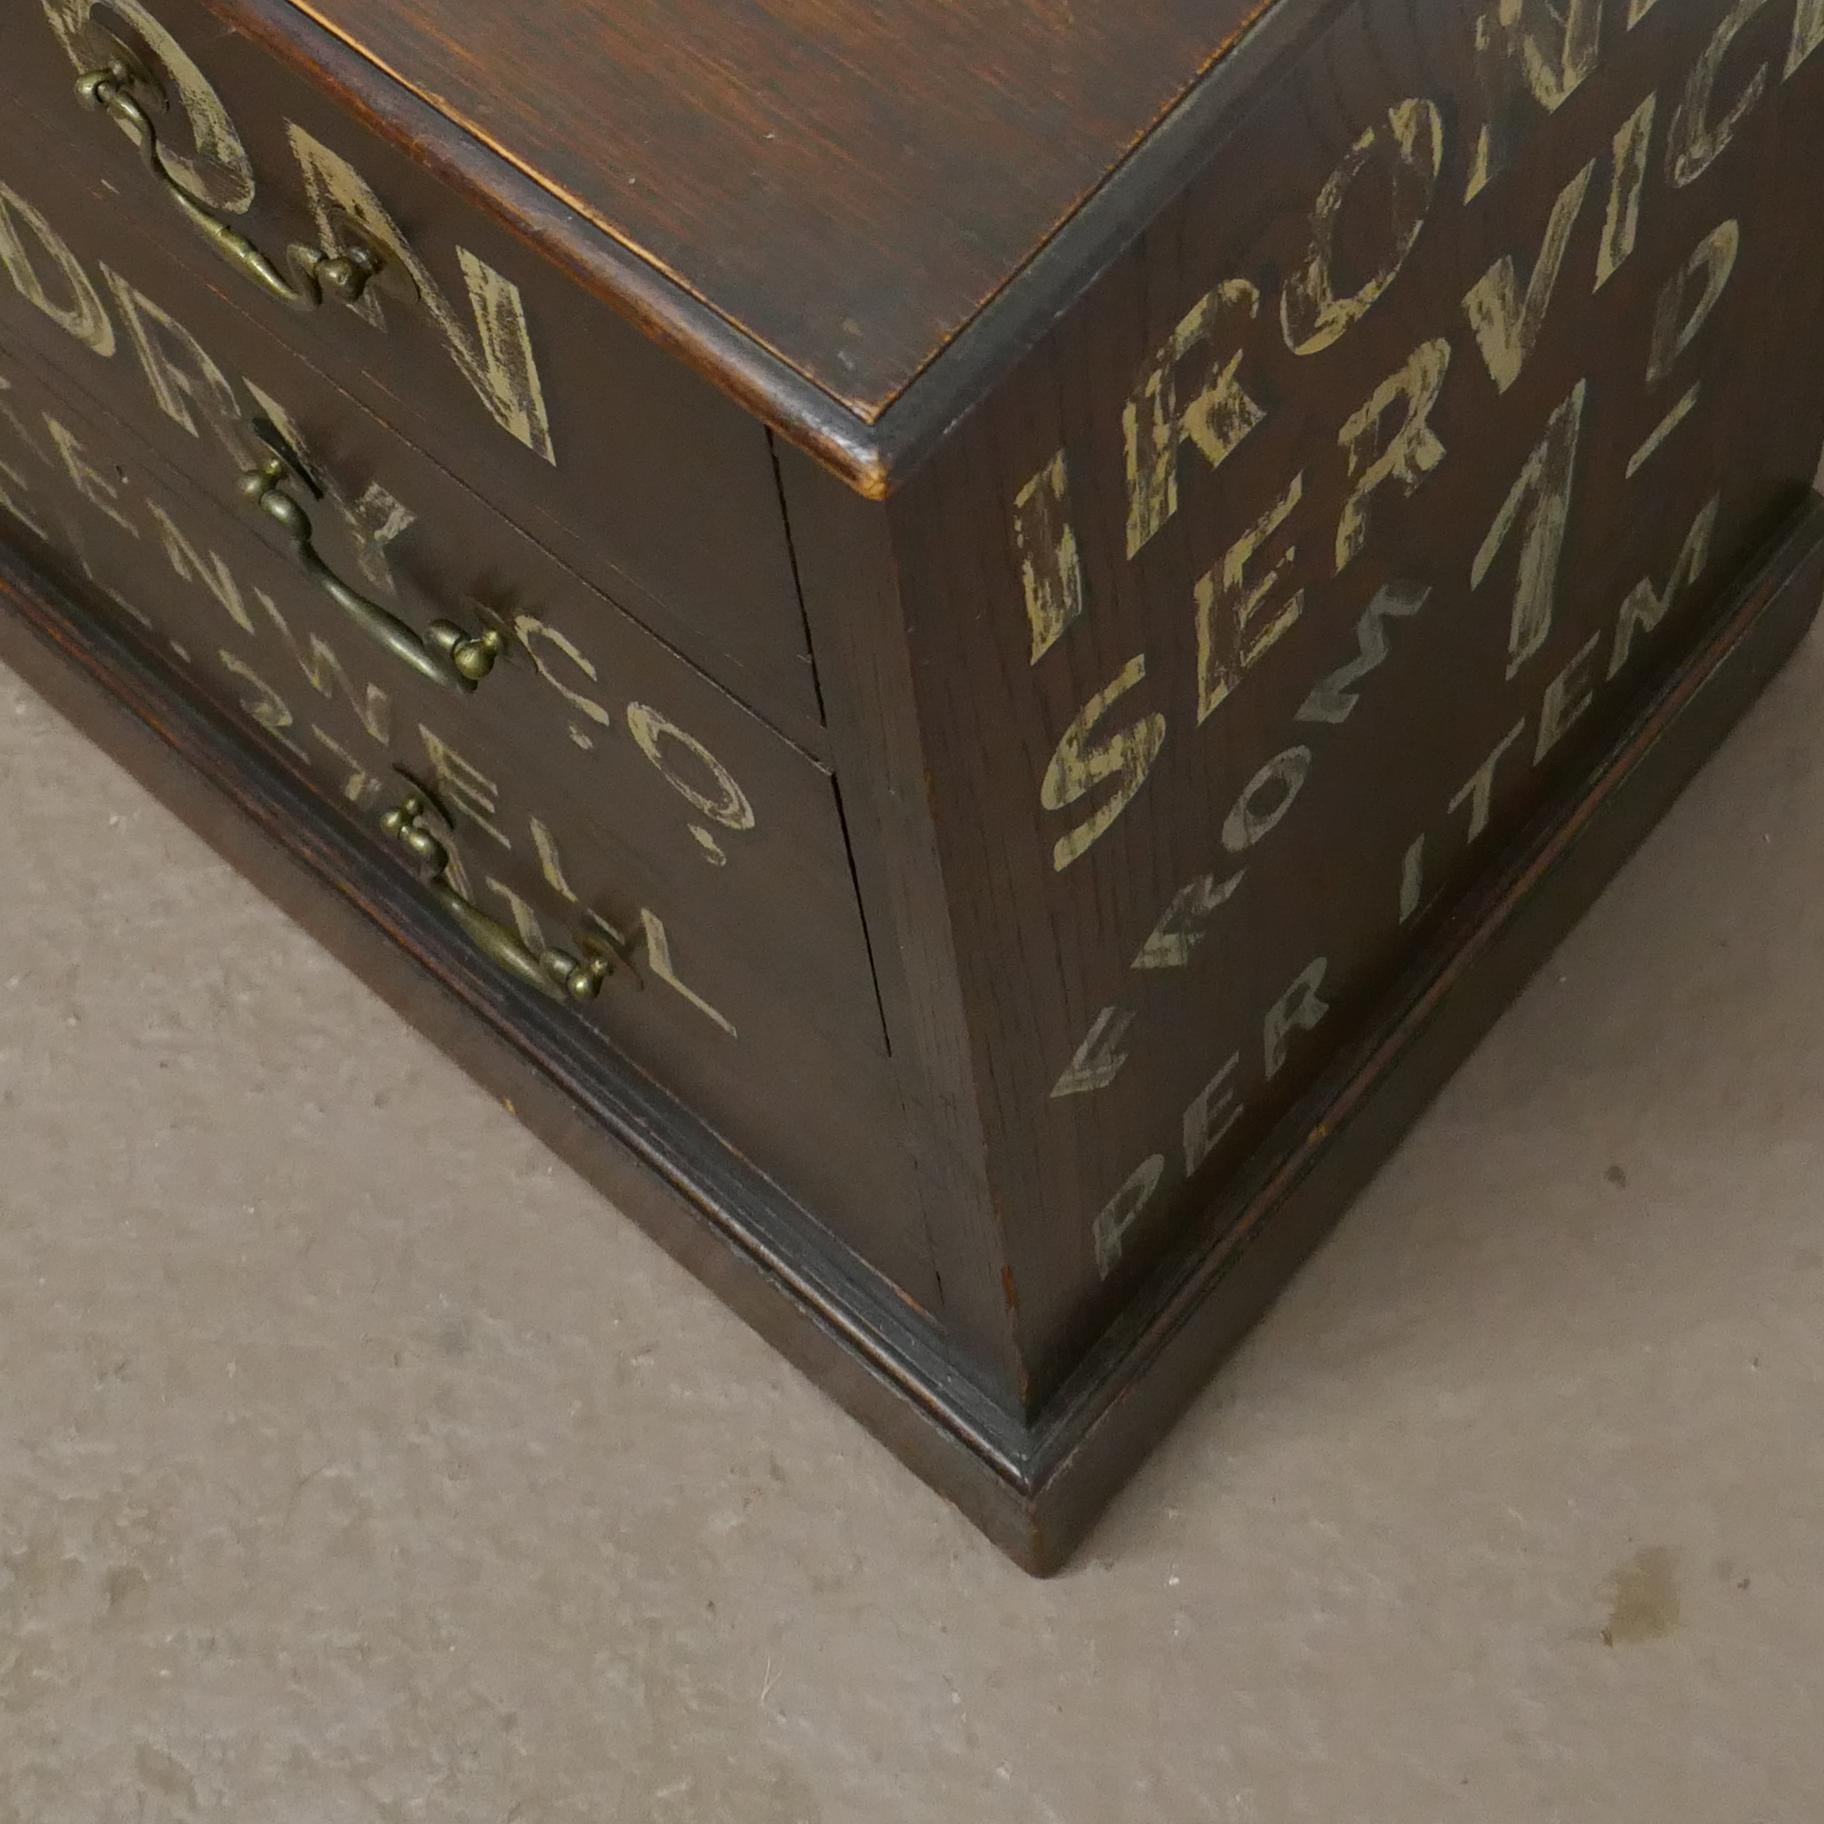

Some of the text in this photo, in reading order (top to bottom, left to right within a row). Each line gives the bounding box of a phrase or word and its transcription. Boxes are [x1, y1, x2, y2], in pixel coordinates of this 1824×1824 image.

[1050, 579, 1432, 1100] FROM
[1093, 490, 1722, 1282] PER ITEM
